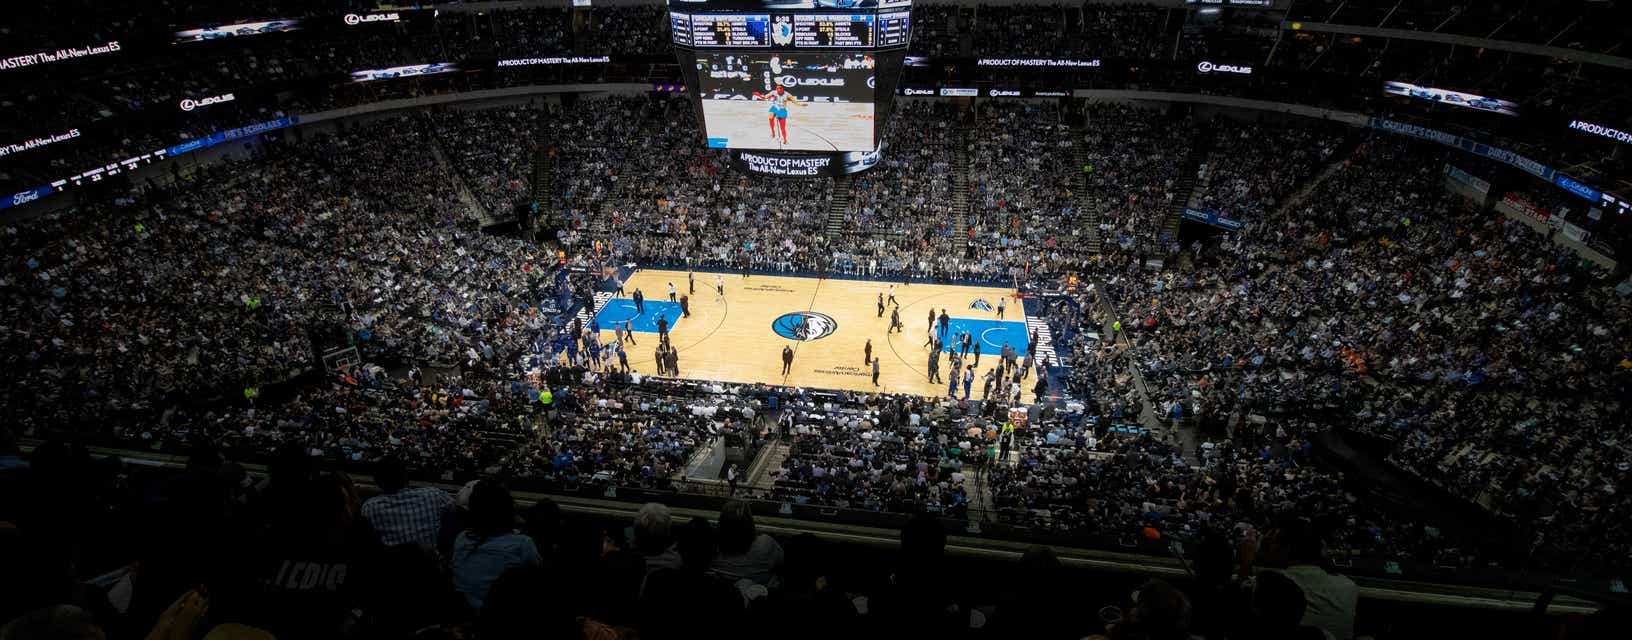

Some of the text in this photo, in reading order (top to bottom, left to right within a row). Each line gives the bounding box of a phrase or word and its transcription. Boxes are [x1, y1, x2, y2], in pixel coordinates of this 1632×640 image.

[360, 13, 400, 22] LEXUS
[39, 53, 56, 63] The
[56, 48, 88, 60] All-New
[87, 45, 109, 55] Lexus
[108, 41, 120, 51] ES
[1212, 64, 1252, 74] LEXUS
[797, 78, 844, 86] LEXUS
[195, 93, 235, 107] LEXUS
[1569, 120, 1576, 128] A
[1577, 121, 1618, 138] PRODUCT
[1617, 131, 1628, 142] OF
[10, 144, 24, 153] The
[69, 128, 80, 138] ES
[740, 152, 831, 168] A PRODUCT OF MASTERY
[749, 162, 818, 175] The All-New Lexus ES
[13, 190, 39, 205] Ford
